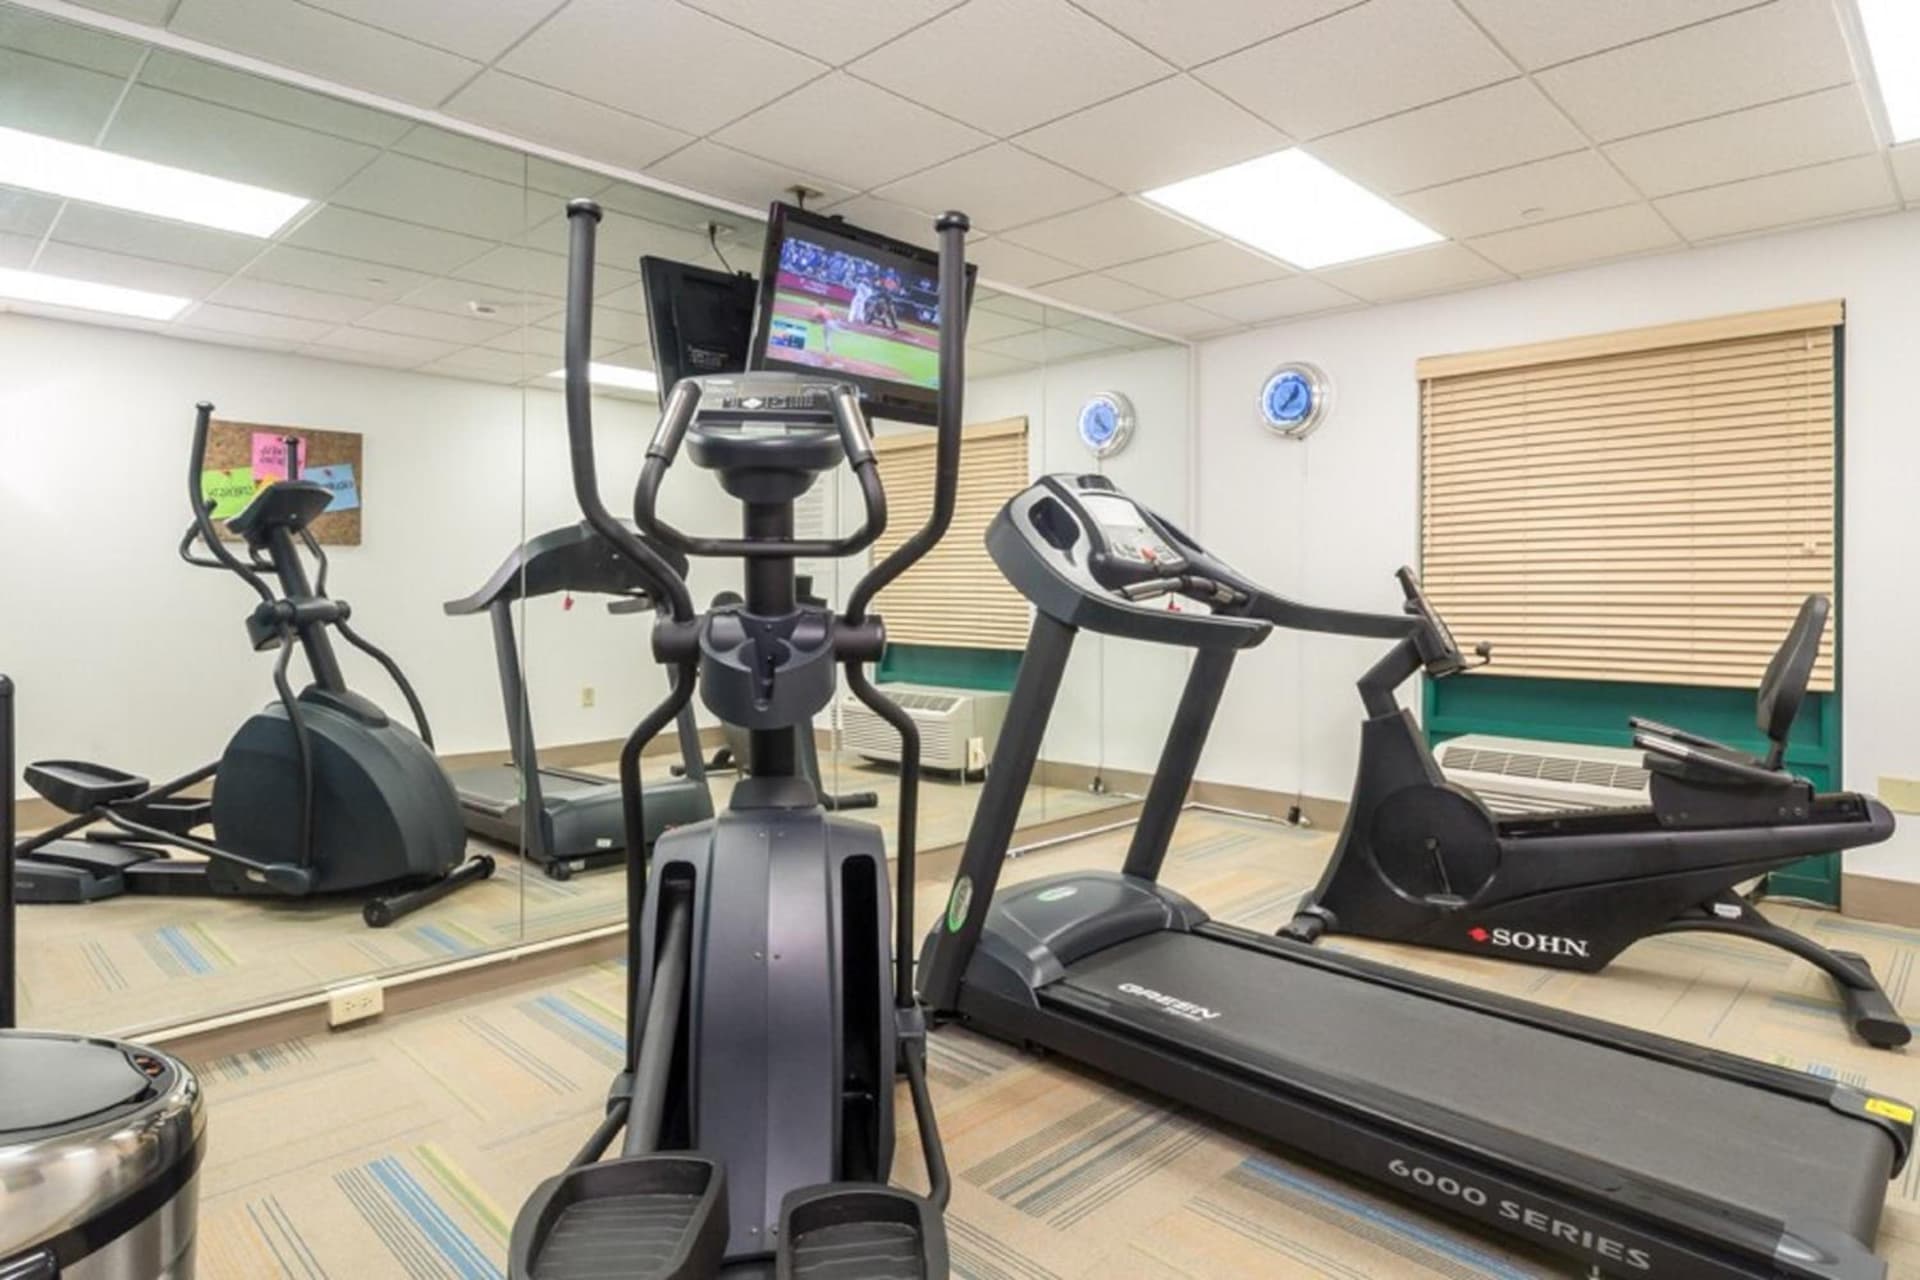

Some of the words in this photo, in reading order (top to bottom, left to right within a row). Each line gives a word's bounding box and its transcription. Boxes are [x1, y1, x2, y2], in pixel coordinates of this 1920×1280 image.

[1491, 928, 1590, 957] SOHN
[1118, 983, 1221, 1018] GREEN
[1388, 1159, 1487, 1207] 6000
[1499, 1200, 1651, 1271] SERIES
